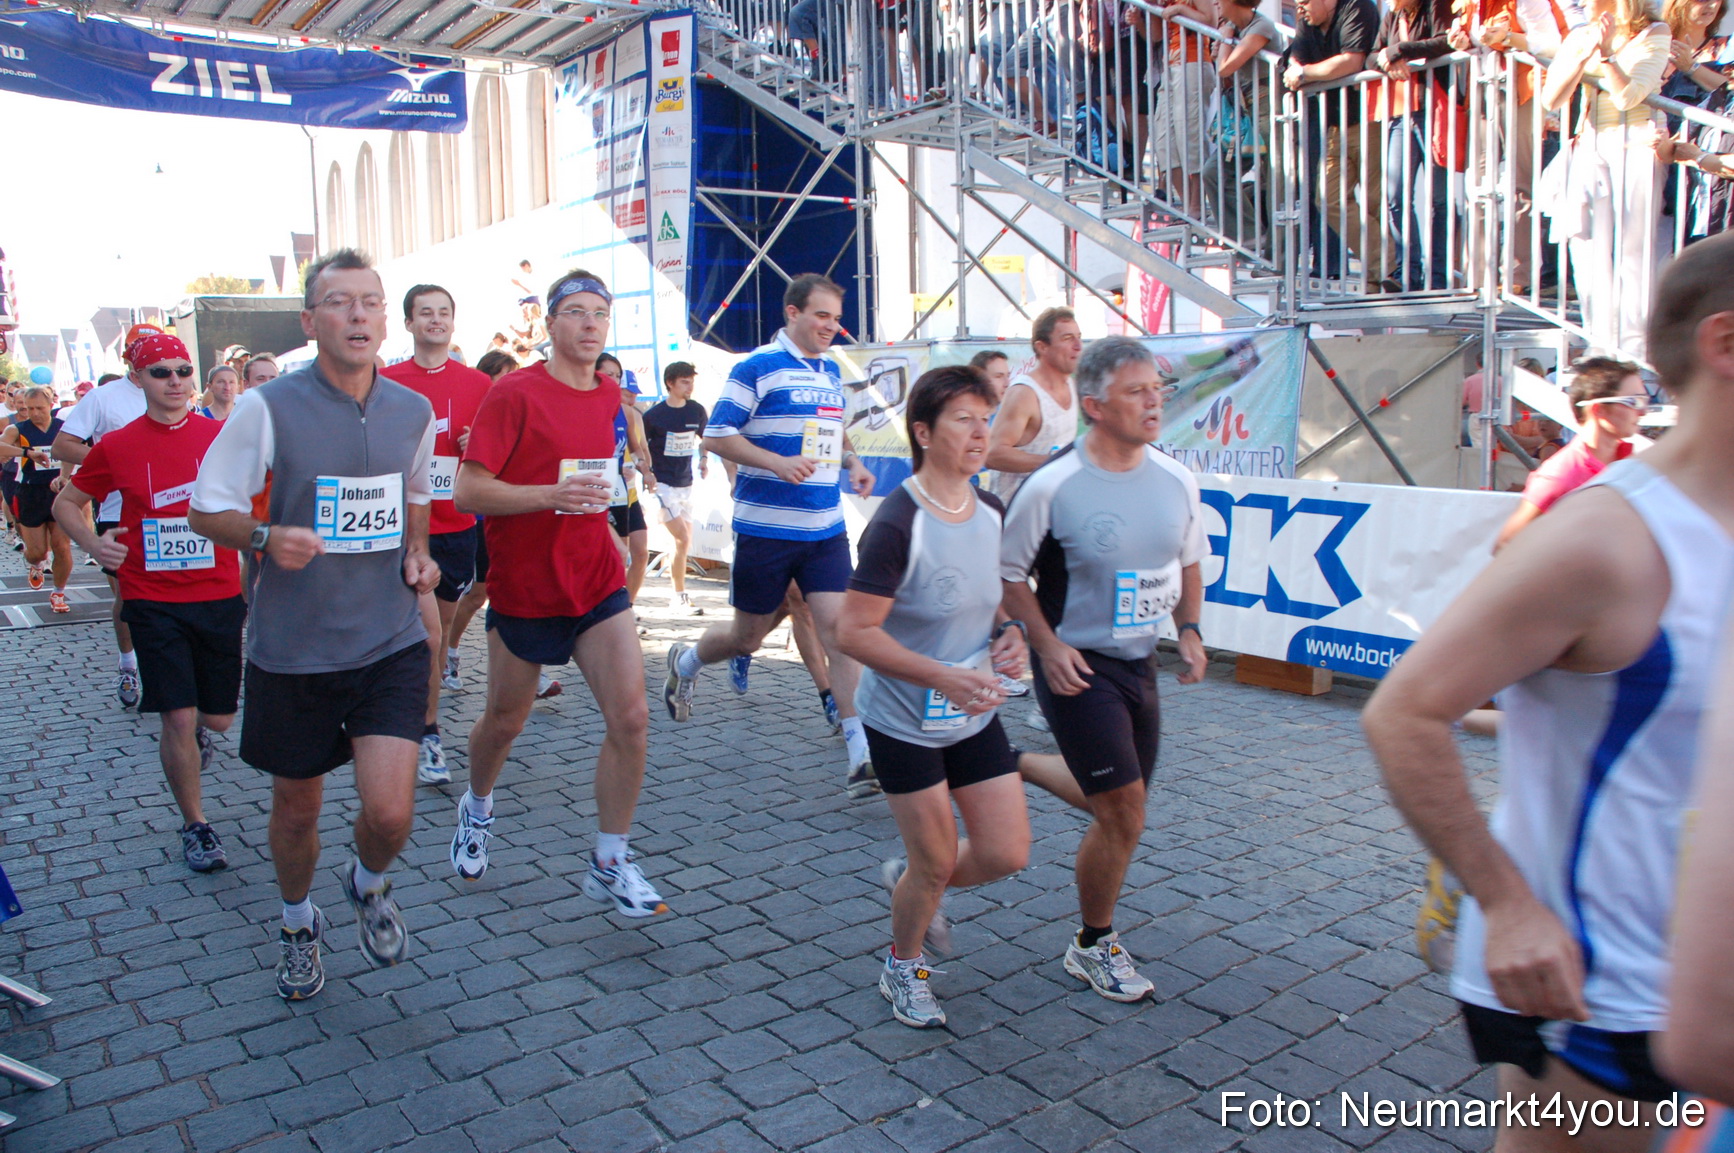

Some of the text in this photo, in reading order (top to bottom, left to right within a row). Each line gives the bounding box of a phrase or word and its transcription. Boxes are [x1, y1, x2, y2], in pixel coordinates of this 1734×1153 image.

[148, 51, 292, 106] ZIEL
[386, 88, 450, 105] MIZUNO
[378, 109, 457, 118] www.mizunoeurope.com
[817, 443, 831, 457] 14
[166, 489, 188, 501] DEHN
[341, 487, 385, 501] Johann
[321, 506, 331, 518] B
[341, 507, 398, 533] 2454
[147, 538, 155, 547] B
[163, 539, 209, 556] 2507
